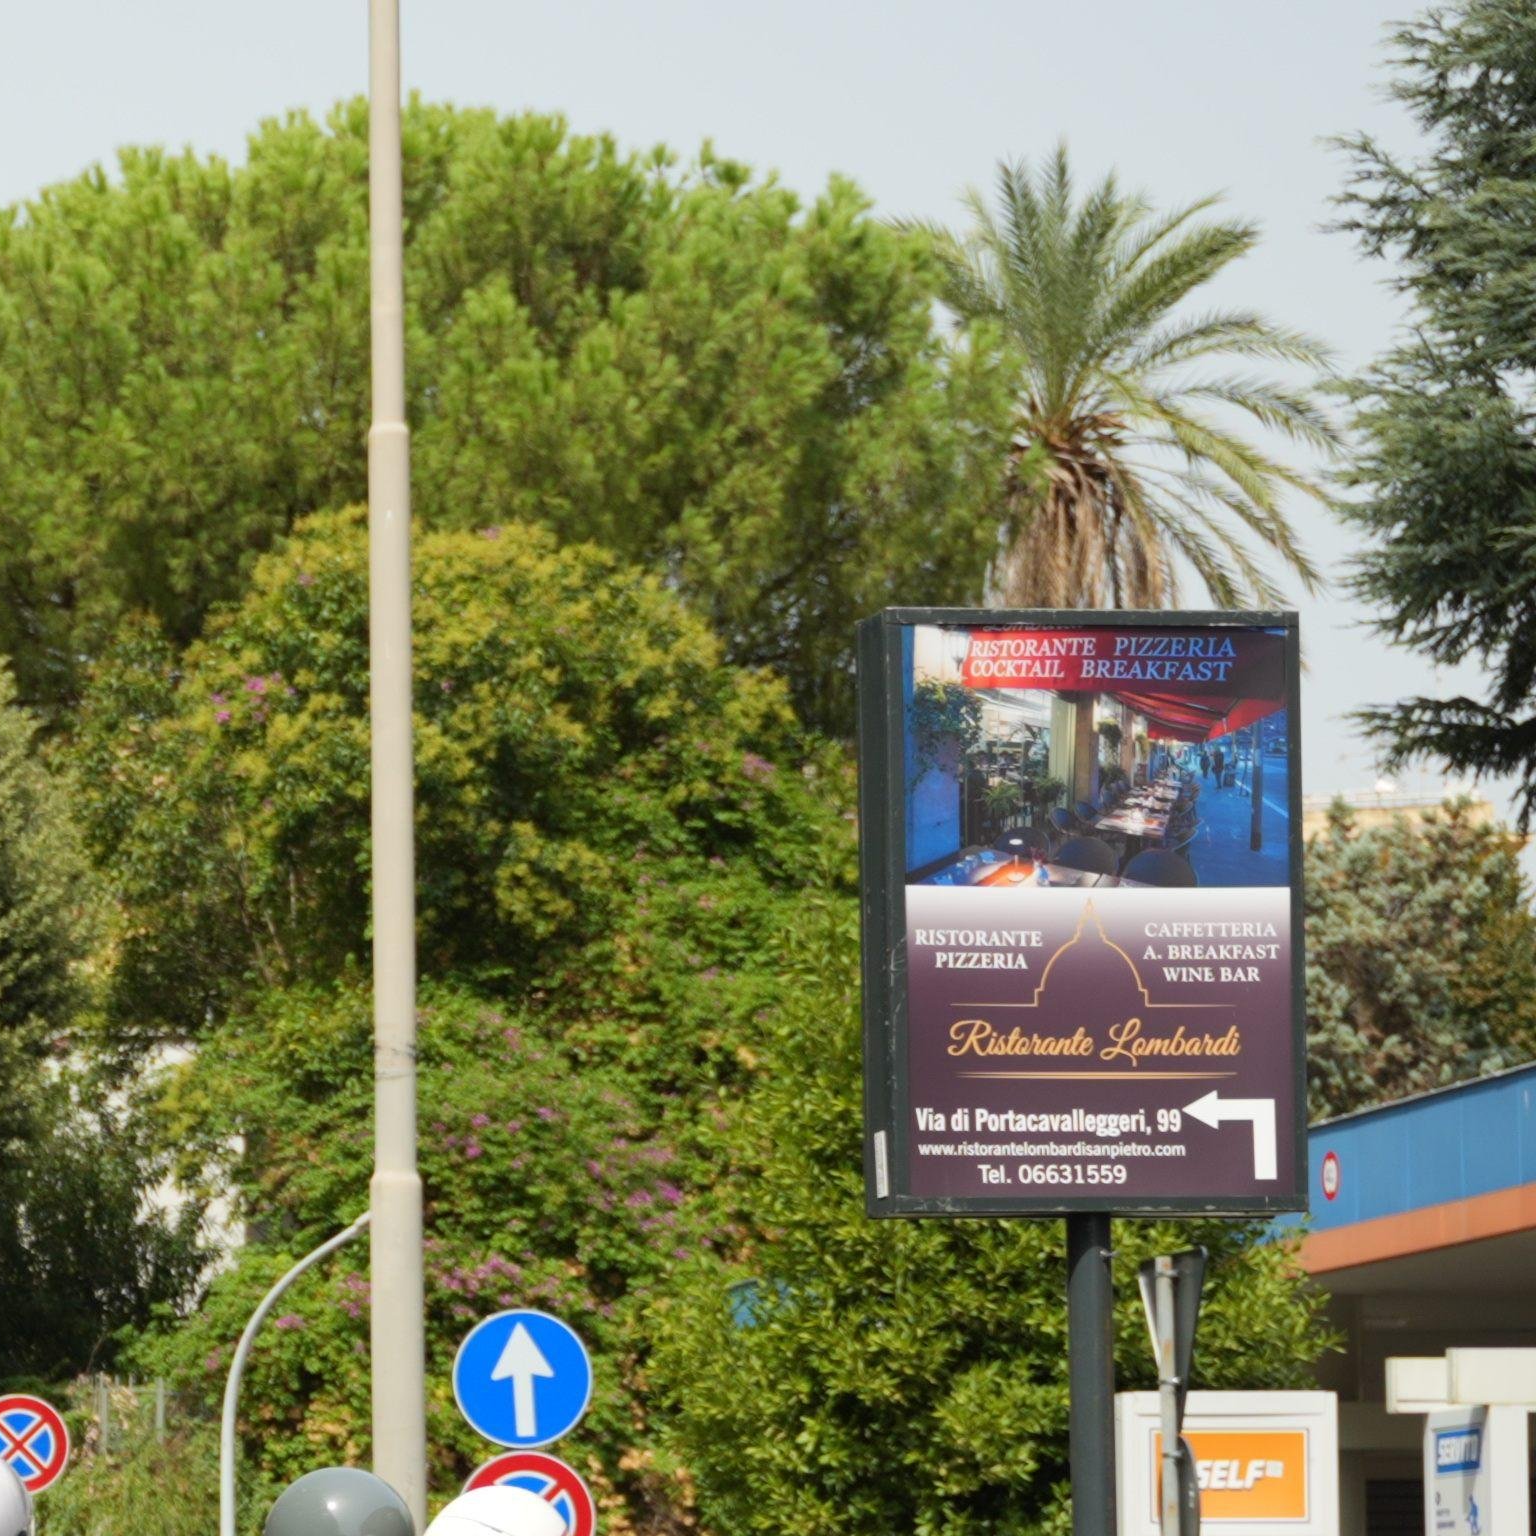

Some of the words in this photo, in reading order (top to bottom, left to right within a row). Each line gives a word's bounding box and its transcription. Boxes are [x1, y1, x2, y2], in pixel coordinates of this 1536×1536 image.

[971, 638, 1096, 657] RISTORANTE
[1114, 637, 1236, 658] PIZZERIA
[970, 659, 1064, 678] COCKTAIL
[1081, 659, 1233, 681] BREAKFAST
[915, 929, 1043, 947] RISTORANTE
[1144, 922, 1277, 938] CAFFETTERIA
[935, 952, 1028, 969] PIZZERIA
[1143, 944, 1162, 960] A.
[1167, 944, 1280, 960] BREAKFAST
[1162, 967, 1215, 982] WINE
[1220, 967, 1260, 982] BAR
[947, 1019, 1093, 1056] Ristorante
[1099, 1018, 1241, 1067] Lombardi
[915, 1108, 946, 1132] Via
[951, 1108, 969, 1132] di
[975, 1108, 1152, 1137] Portacavalleggeri,
[1157, 1108, 1182, 1132] 99
[918, 1141, 1186, 1159] www.ristorantelombardisanpietro.com
[977, 1164, 1011, 1184] Tel.
[1018, 1164, 1127, 1184] 06631559
[1196, 1459, 1266, 1490] SELF
